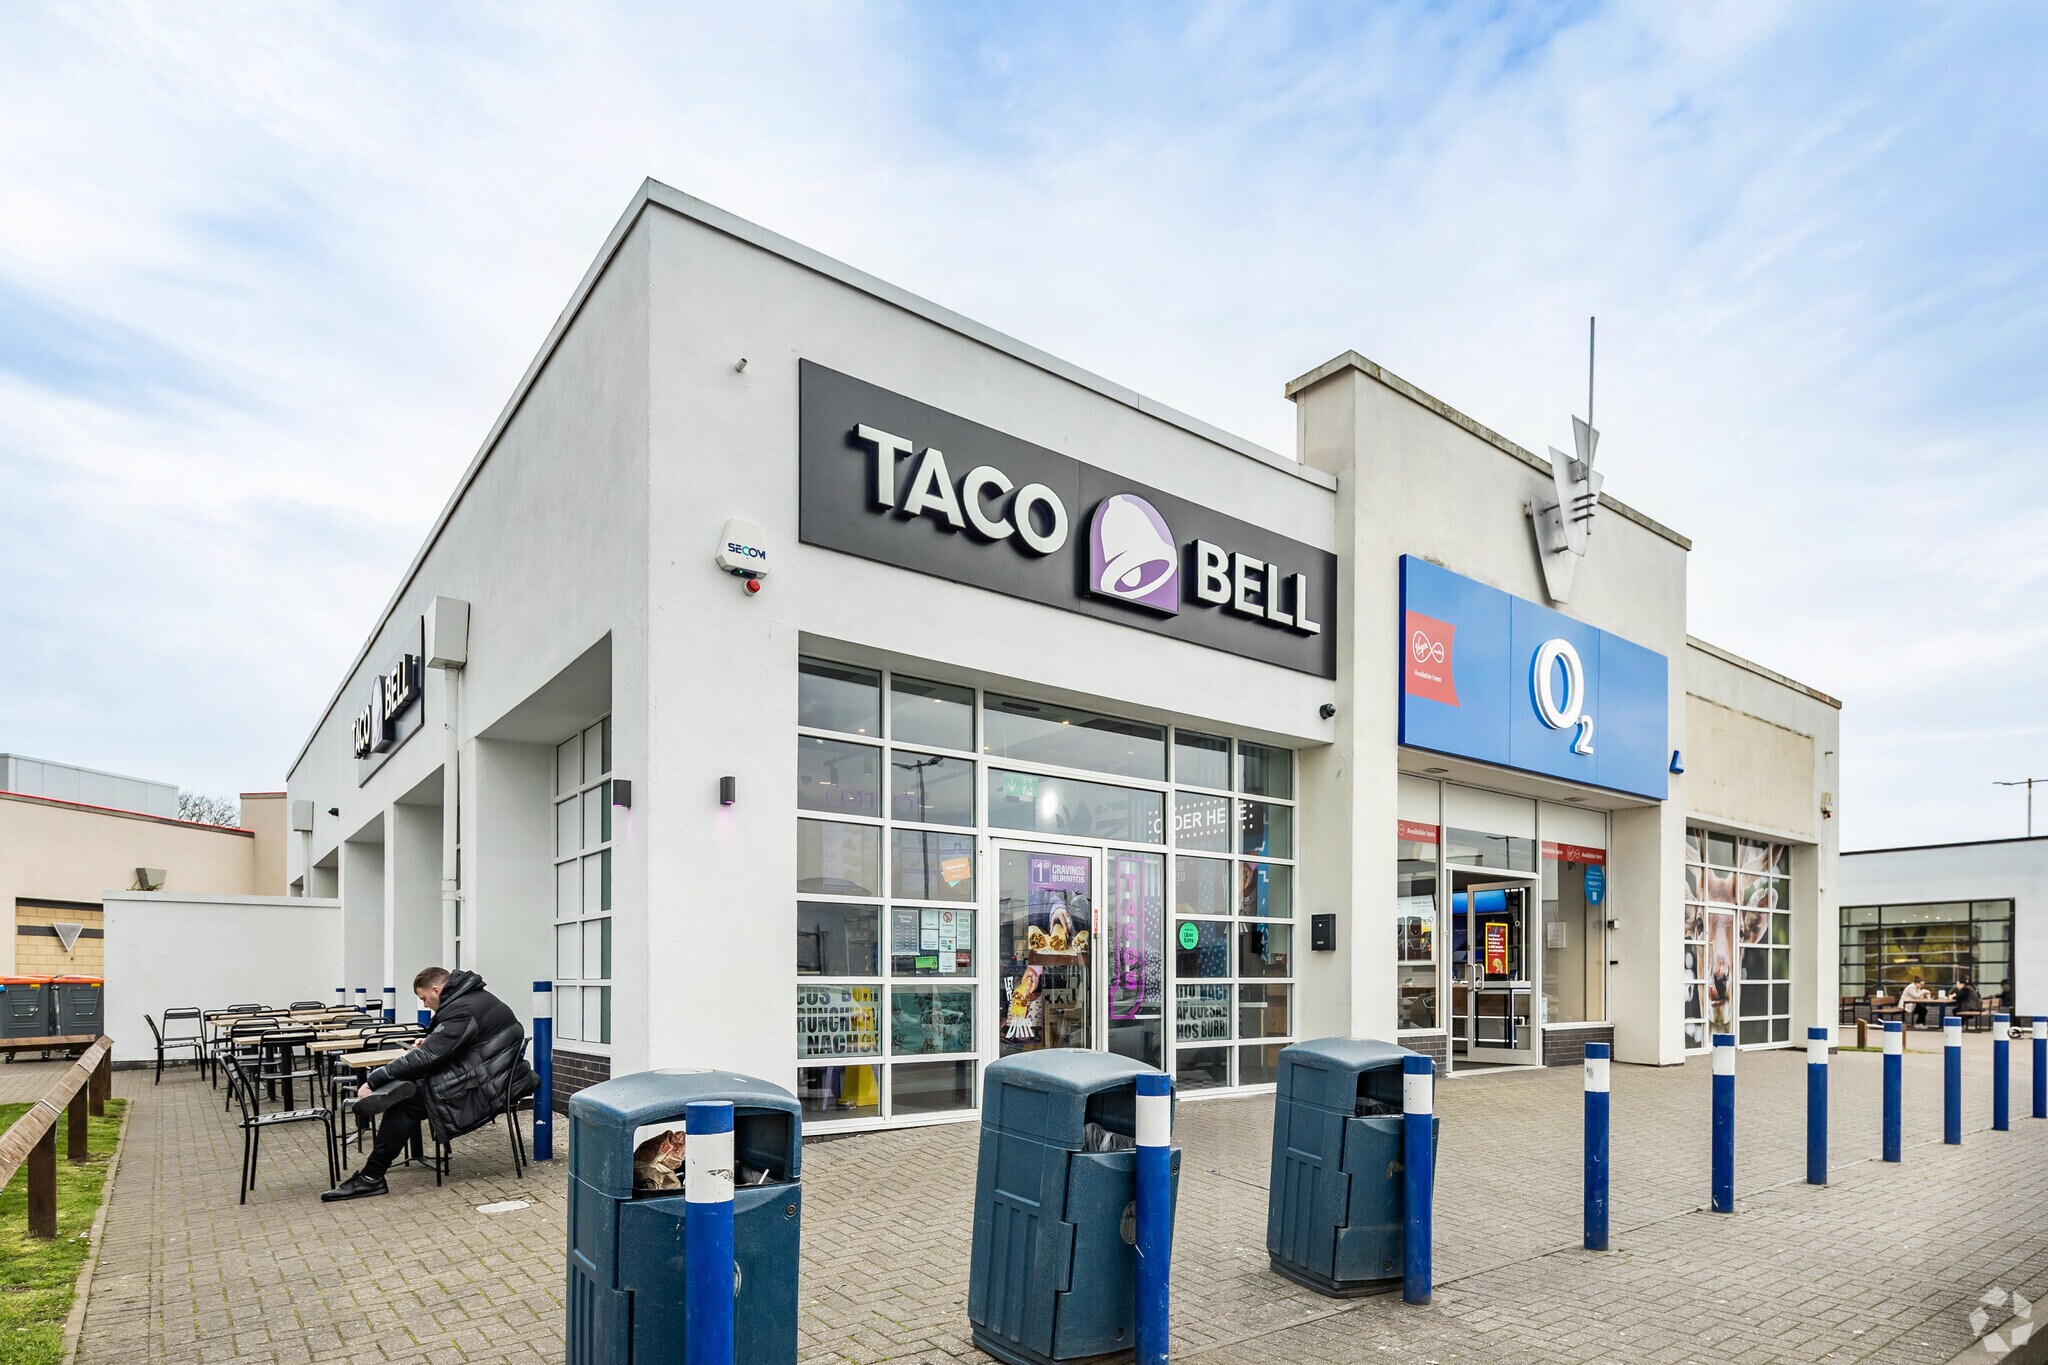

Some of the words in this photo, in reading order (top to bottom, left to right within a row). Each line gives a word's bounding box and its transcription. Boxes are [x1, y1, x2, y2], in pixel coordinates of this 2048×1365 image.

[853, 423, 1069, 554] TACO
[1191, 539, 1321, 634] BELL
[727, 542, 766, 560] SECOM
[1414, 669, 1433, 681] Available
[1432, 674, 1442, 683] here
[1529, 638, 1594, 755] O2
[352, 704, 372, 759] TACO
[384, 654, 413, 721] BELL
[1153, 811, 1202, 835] ODER
[1206, 804, 1248, 826] HEE
[1406, 827, 1426, 837] Available
[1426, 829, 1436, 838] here
[1542, 846, 1556, 855] vailable
[1052, 864, 1085, 876] CRAVINGS
[1052, 874, 1085, 884] BURRITOS
[1120, 873, 1139, 990] TACOS
